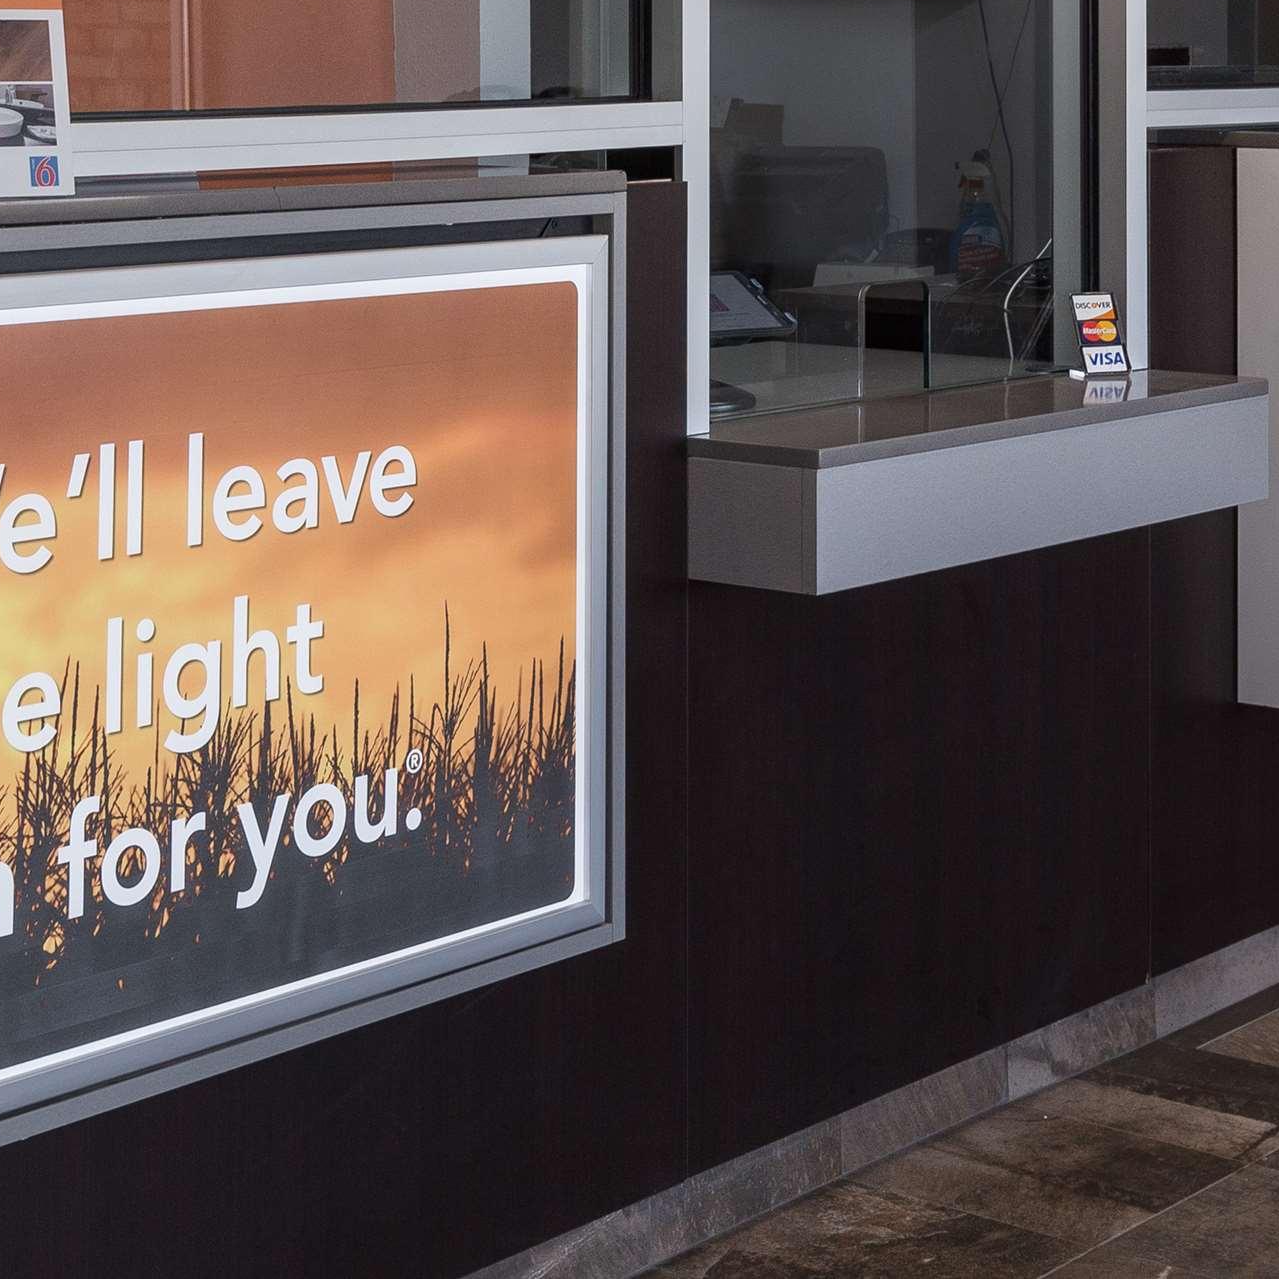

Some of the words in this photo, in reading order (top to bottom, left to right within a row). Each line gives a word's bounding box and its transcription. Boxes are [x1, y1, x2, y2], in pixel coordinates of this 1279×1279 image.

[34, 154, 57, 187] 6
[1075, 301, 1112, 310] DISCOVER
[1088, 351, 1125, 366] VISA
[187, 431, 419, 549] leave
[104, 594, 325, 756] light
[57, 796, 207, 920] for
